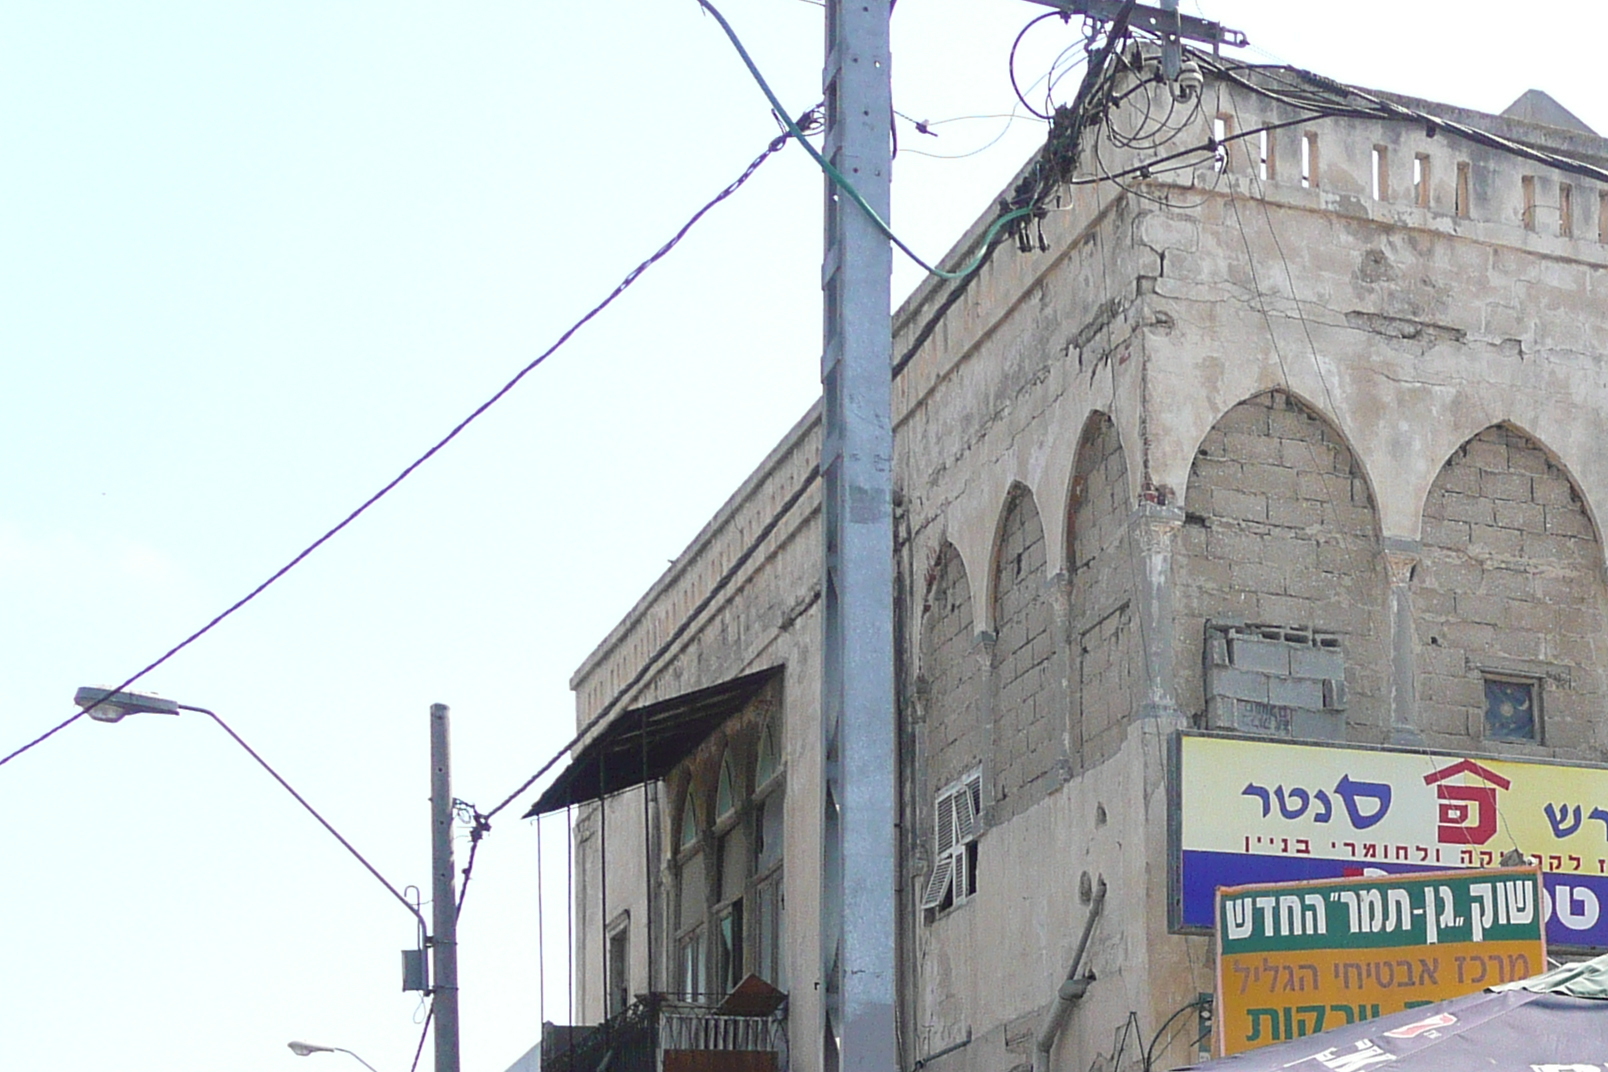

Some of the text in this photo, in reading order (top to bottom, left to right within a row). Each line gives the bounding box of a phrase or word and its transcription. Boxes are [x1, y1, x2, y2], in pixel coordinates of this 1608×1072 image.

[1241, 774, 1392, 830] סנטר
[1244, 836, 1311, 854] בניין
[1331, 842, 1440, 863] ולחומרי
[1460, 849, 1581, 872] לקריקה
[1225, 892, 1327, 940] החדש
[1469, 880, 1535, 943] שוק
[1232, 953, 1530, 996] מרכז אבטיחי הגליל
